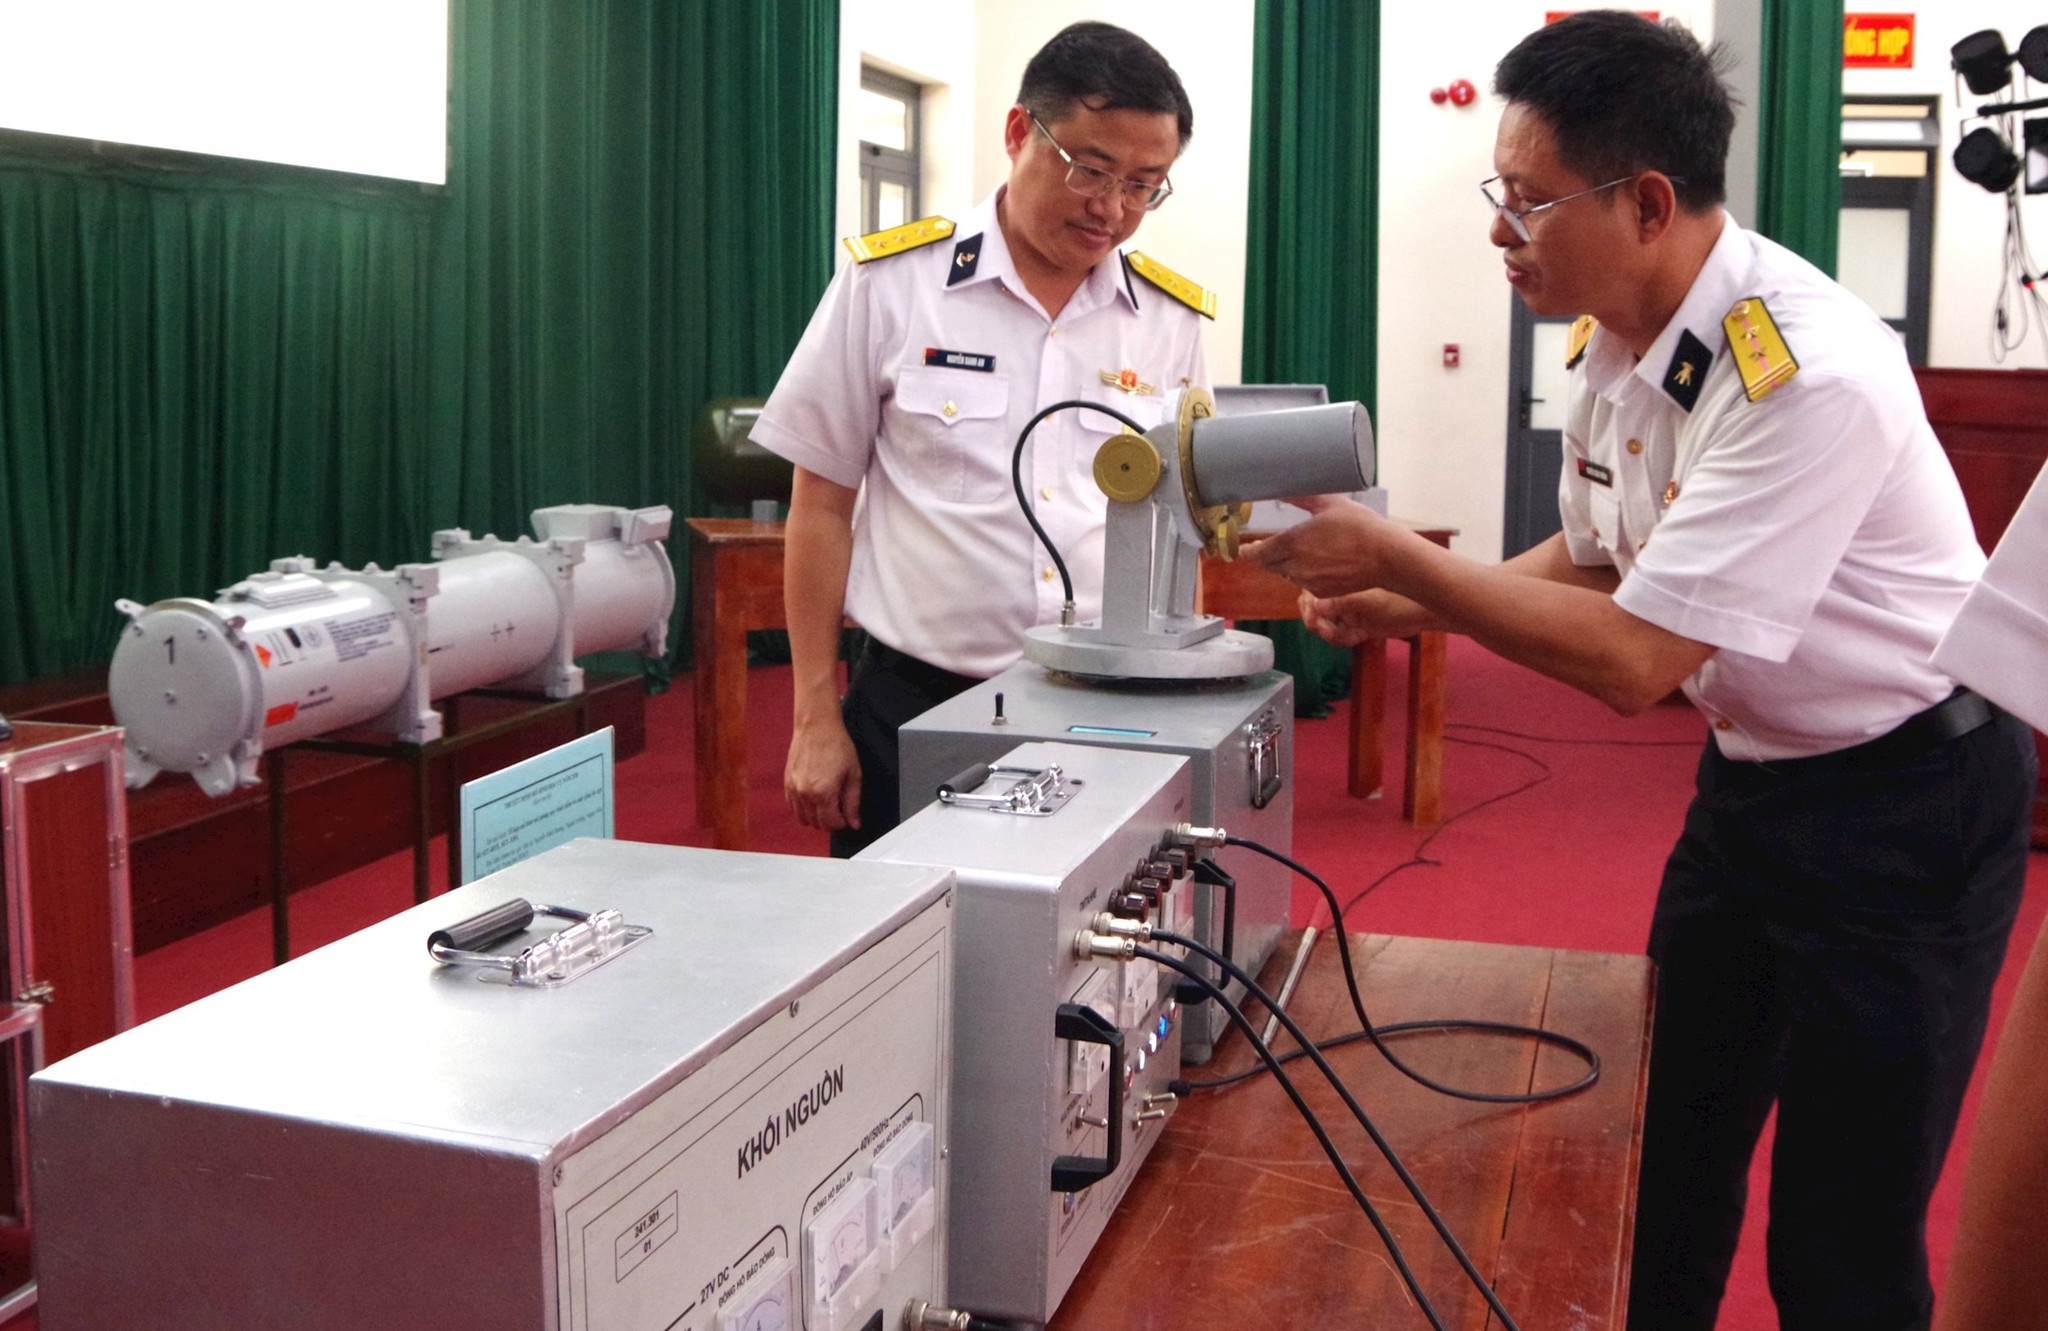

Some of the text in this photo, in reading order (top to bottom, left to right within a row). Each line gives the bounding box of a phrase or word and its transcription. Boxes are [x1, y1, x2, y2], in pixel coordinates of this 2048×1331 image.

[163, 635, 175, 665] 1
[738, 1064, 844, 1180] KHỐI NGUỒN
[634, 1209, 660, 1238] 241.301
[643, 1238, 652, 1253] 01
[700, 1266, 730, 1305] 27V DC
